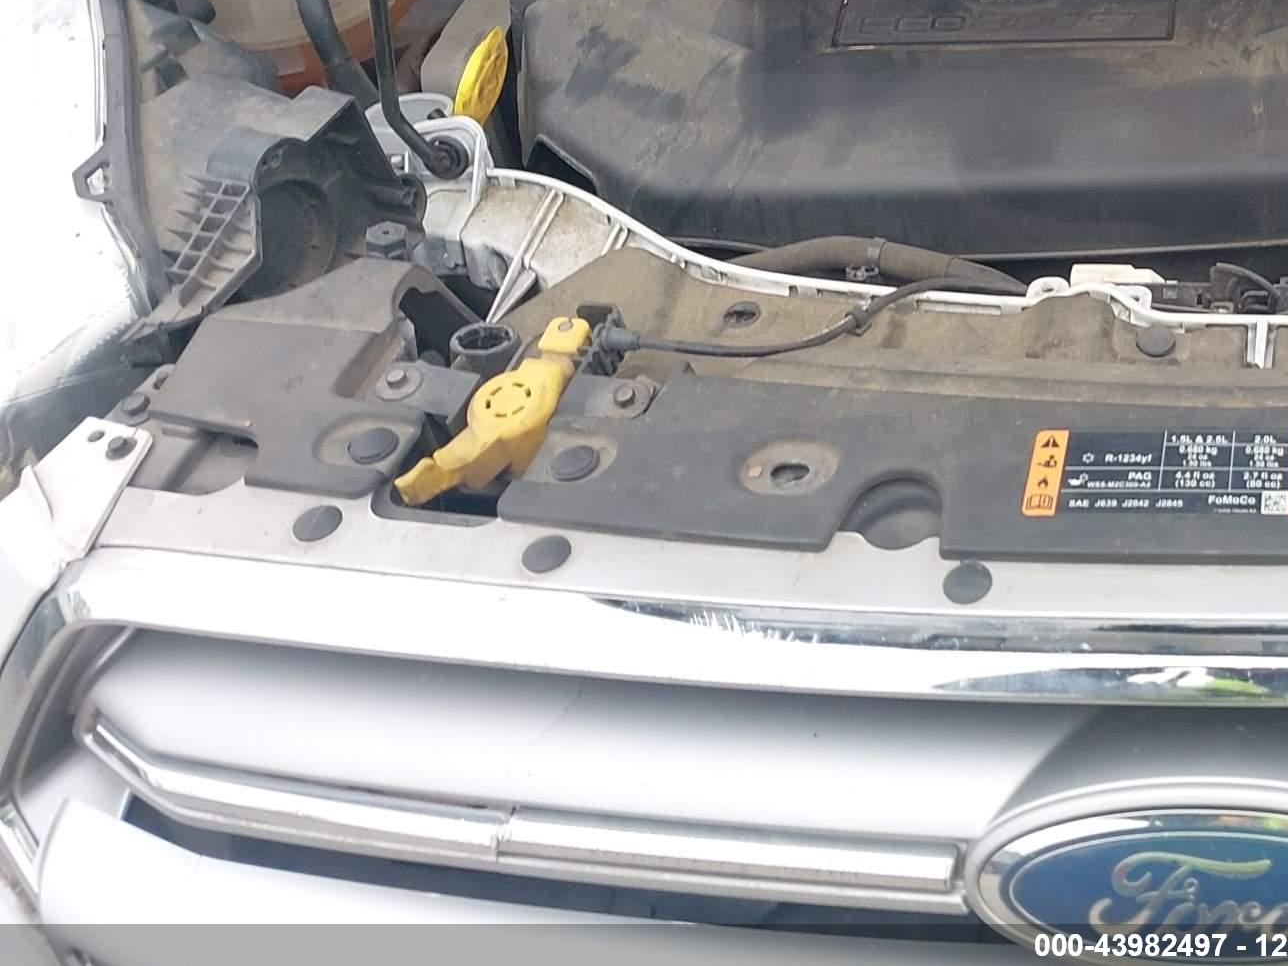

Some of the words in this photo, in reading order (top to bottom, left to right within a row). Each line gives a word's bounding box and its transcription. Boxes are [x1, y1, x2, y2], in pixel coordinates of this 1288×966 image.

[1254, 434, 1277, 445] 2.0L
[1206, 445, 1218, 456] kg
[1272, 446, 1284, 457] kg
[1104, 453, 1152, 465] R-1234yf
[1127, 471, 1152, 481] PAG
[1068, 498, 1090, 508] SAE
[1207, 494, 1256, 506] FoMoCo
